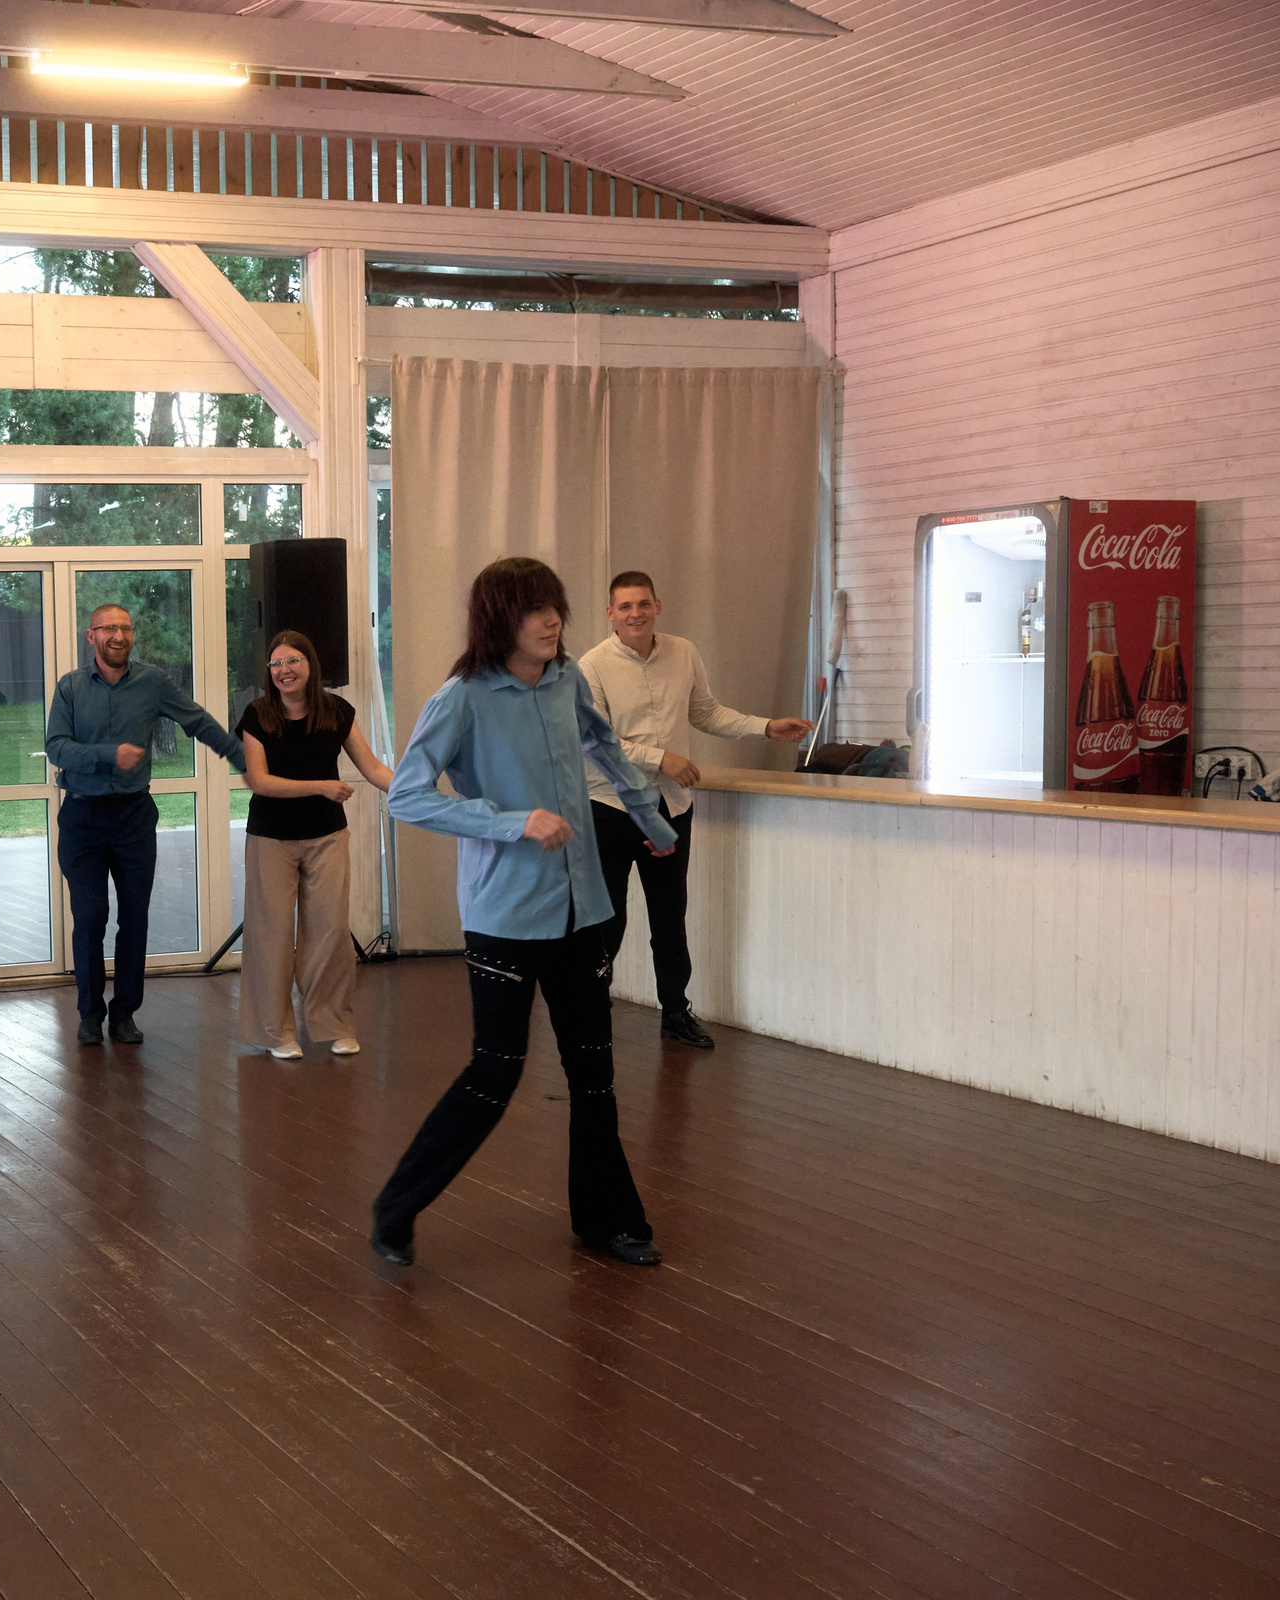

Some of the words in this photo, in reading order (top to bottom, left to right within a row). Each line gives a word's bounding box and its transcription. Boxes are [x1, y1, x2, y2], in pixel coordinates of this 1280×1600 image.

[1078, 523, 1188, 570] Coca-Cola
[1136, 703, 1187, 729] Coca-Cola
[1076, 722, 1134, 756] Coca-Cola
[1149, 729, 1169, 737] zero
